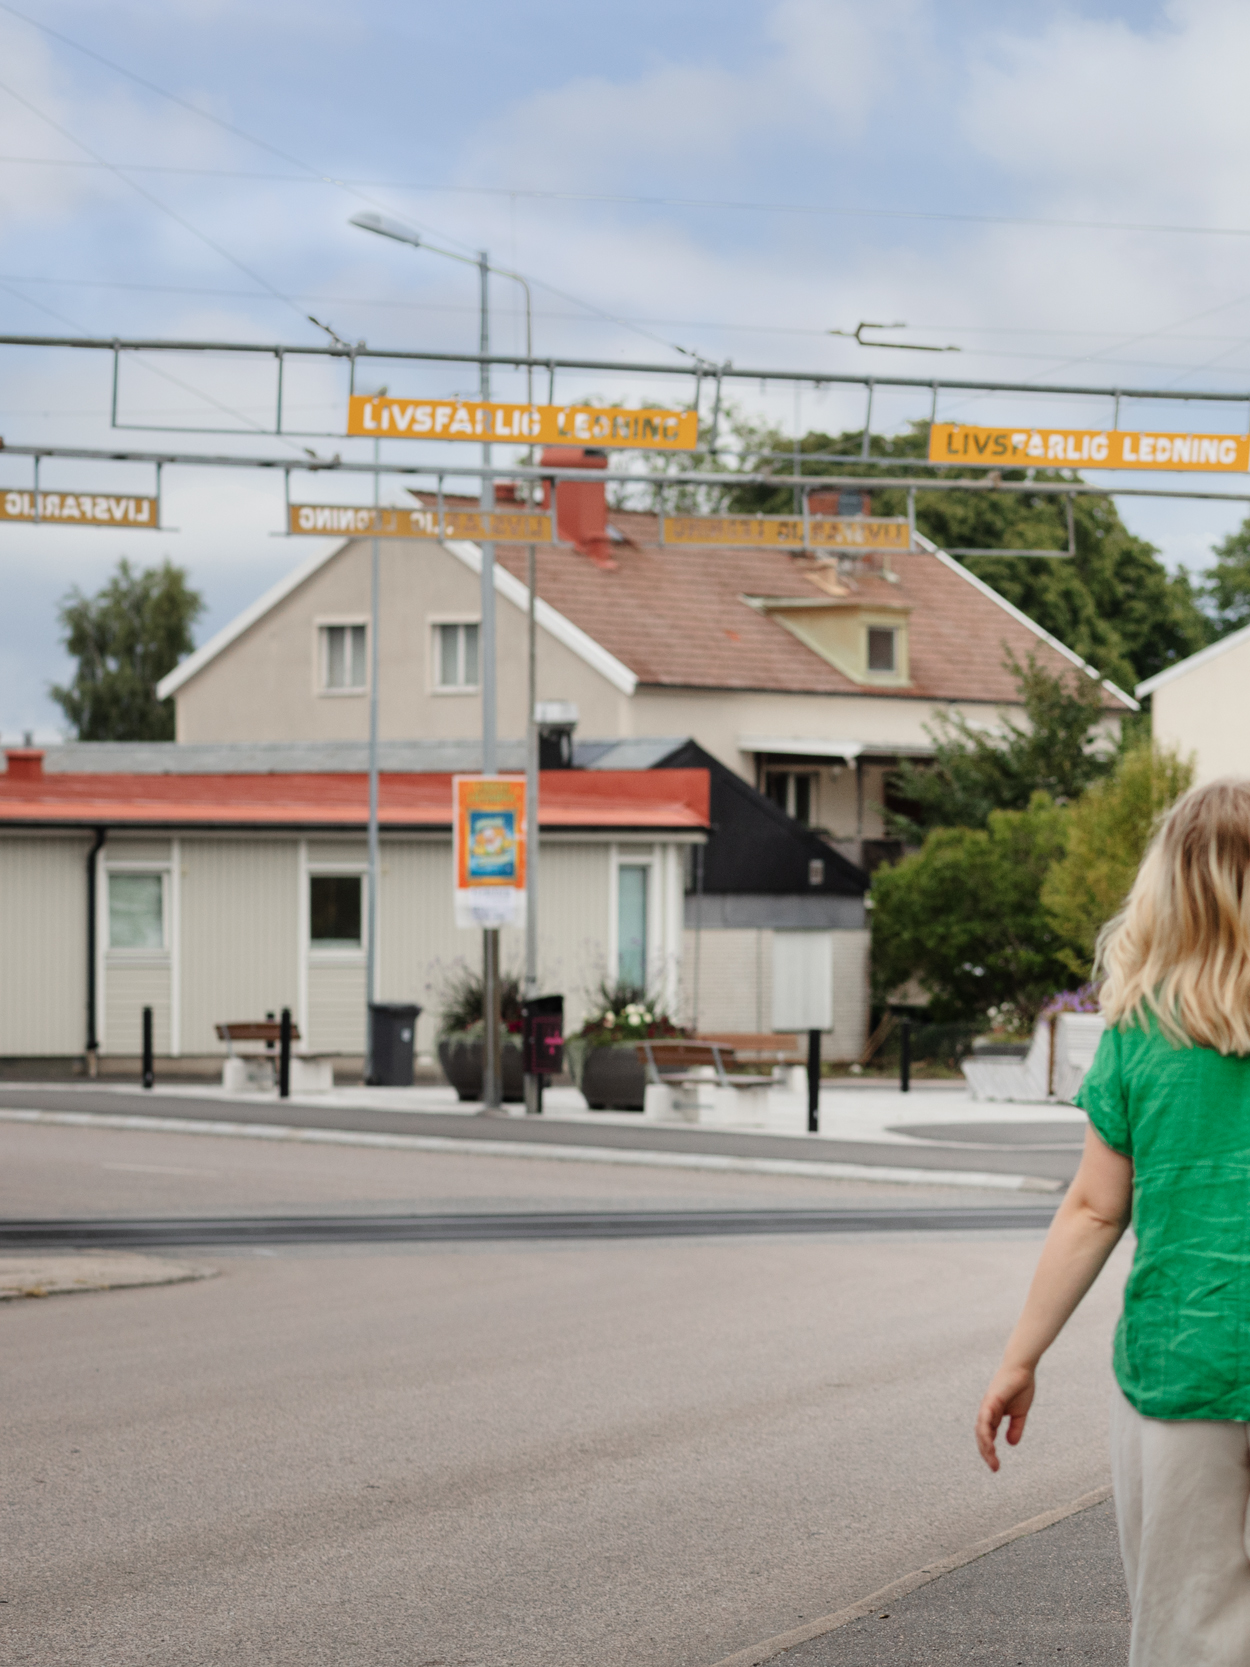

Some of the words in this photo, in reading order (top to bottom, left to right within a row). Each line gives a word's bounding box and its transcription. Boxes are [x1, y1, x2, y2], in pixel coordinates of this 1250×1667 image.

[363, 403, 541, 436] LIVSFARLIG
[557, 411, 679, 442] LEDNING
[947, 433, 1109, 461] LIVSFARLIG
[1122, 436, 1238, 464] LEDNING
